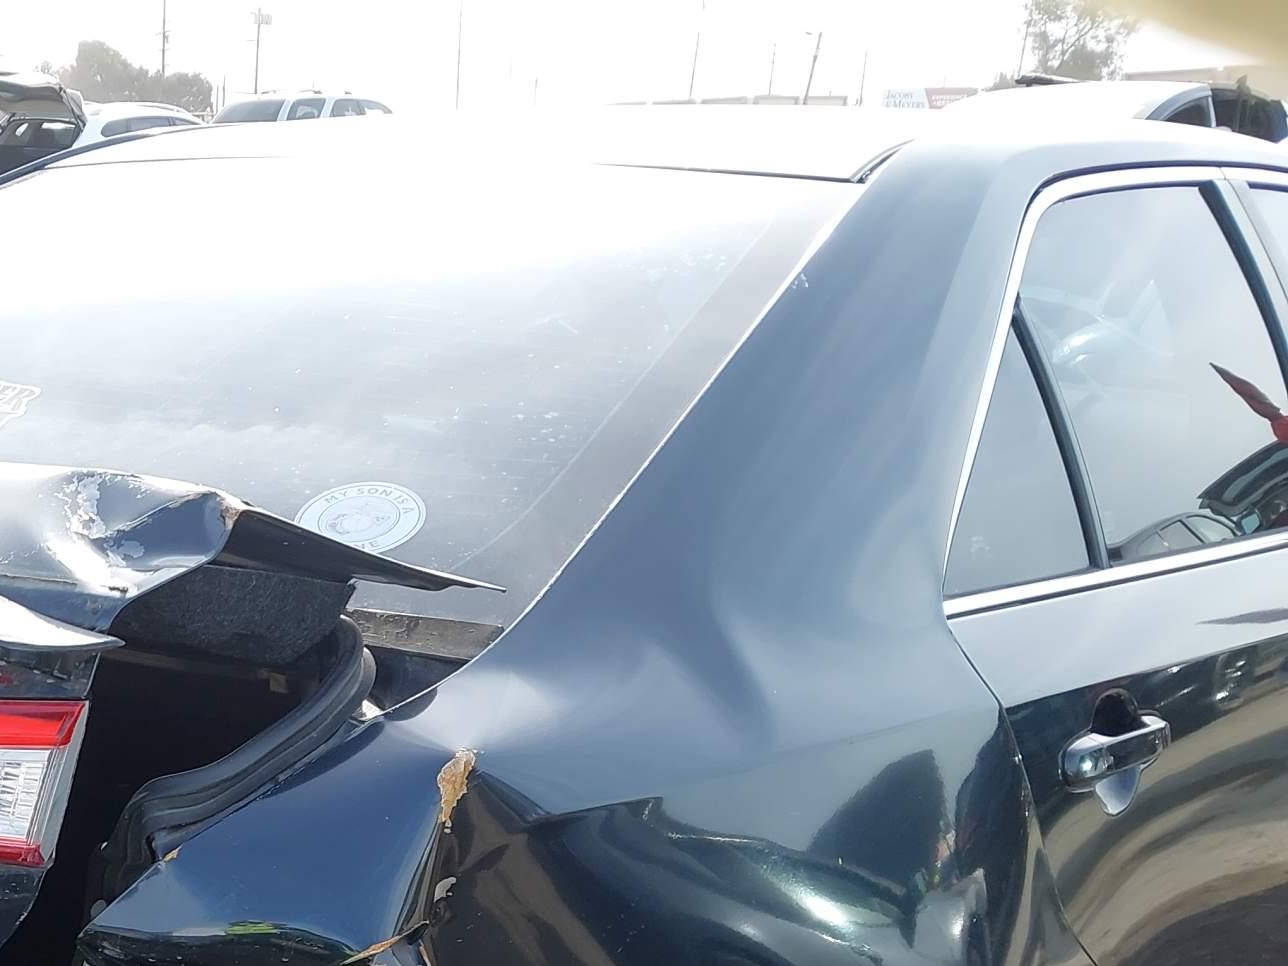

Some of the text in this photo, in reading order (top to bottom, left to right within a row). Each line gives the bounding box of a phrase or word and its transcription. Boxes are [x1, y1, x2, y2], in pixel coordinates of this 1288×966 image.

[324, 490, 348, 504] MY
[357, 487, 393, 498] SON
[394, 494, 410, 505] IS
